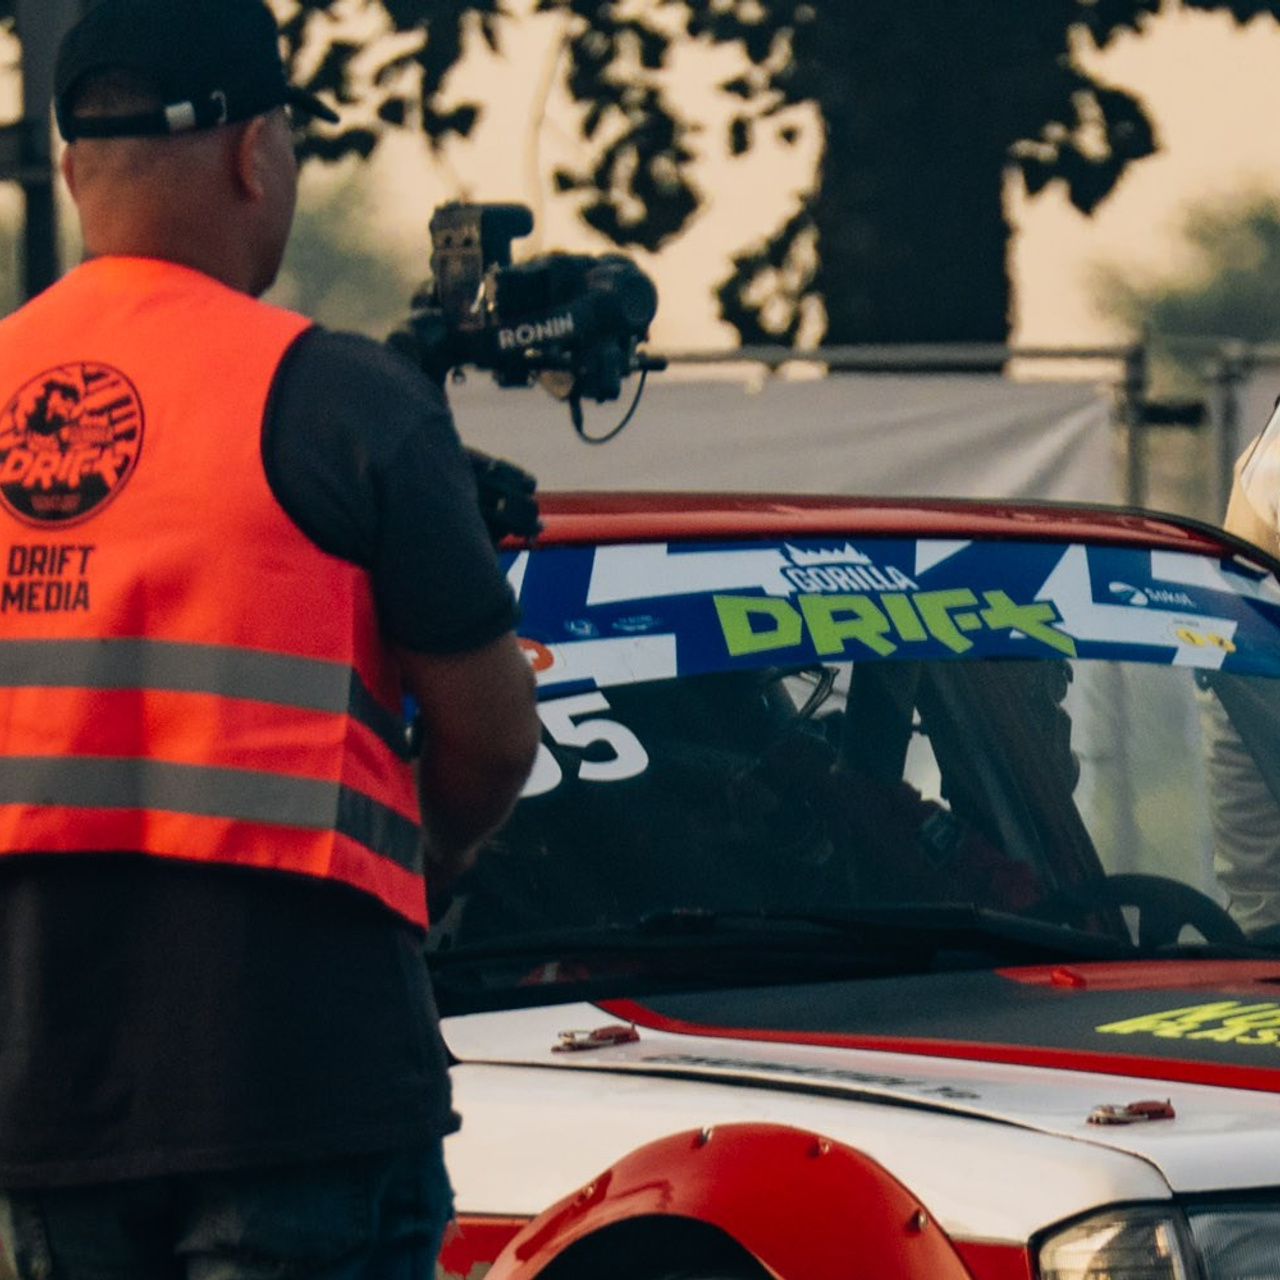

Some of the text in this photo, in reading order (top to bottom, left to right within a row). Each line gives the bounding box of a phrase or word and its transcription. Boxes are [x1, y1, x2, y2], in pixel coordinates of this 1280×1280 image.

[499, 313, 574, 349] RONIN
[8, 545, 96, 576] DRIFT
[784, 564, 919, 592] GORILLA
[1, 581, 90, 612] MEDIA
[713, 588, 1077, 657] DRIFT
